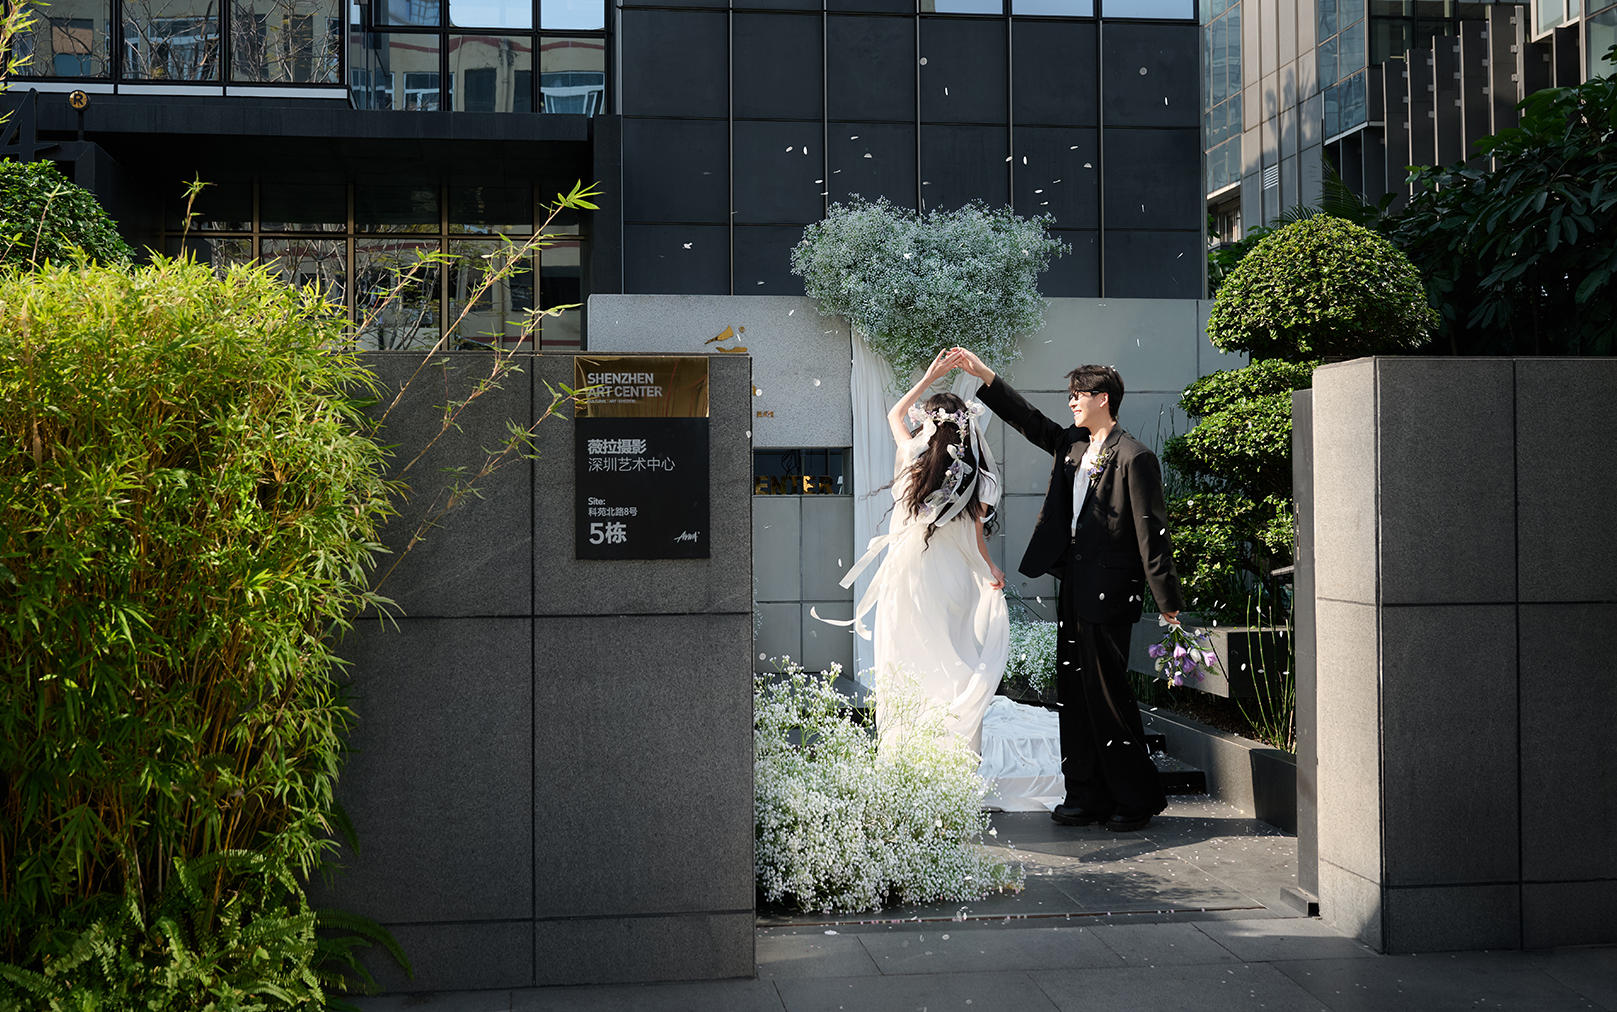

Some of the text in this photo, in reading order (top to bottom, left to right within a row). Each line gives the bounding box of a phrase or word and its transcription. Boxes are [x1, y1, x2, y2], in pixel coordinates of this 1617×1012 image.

[587, 372, 654, 385] SHENZHEN
[588, 385, 663, 397] ART CENTER
[587, 438, 647, 455] 薇拉摄影
[588, 456, 676, 472] 深圳艺术中心
[587, 497, 606, 506] Site:
[588, 507, 638, 517] 科苑北路8号
[589, 521, 628, 545] 5栋
